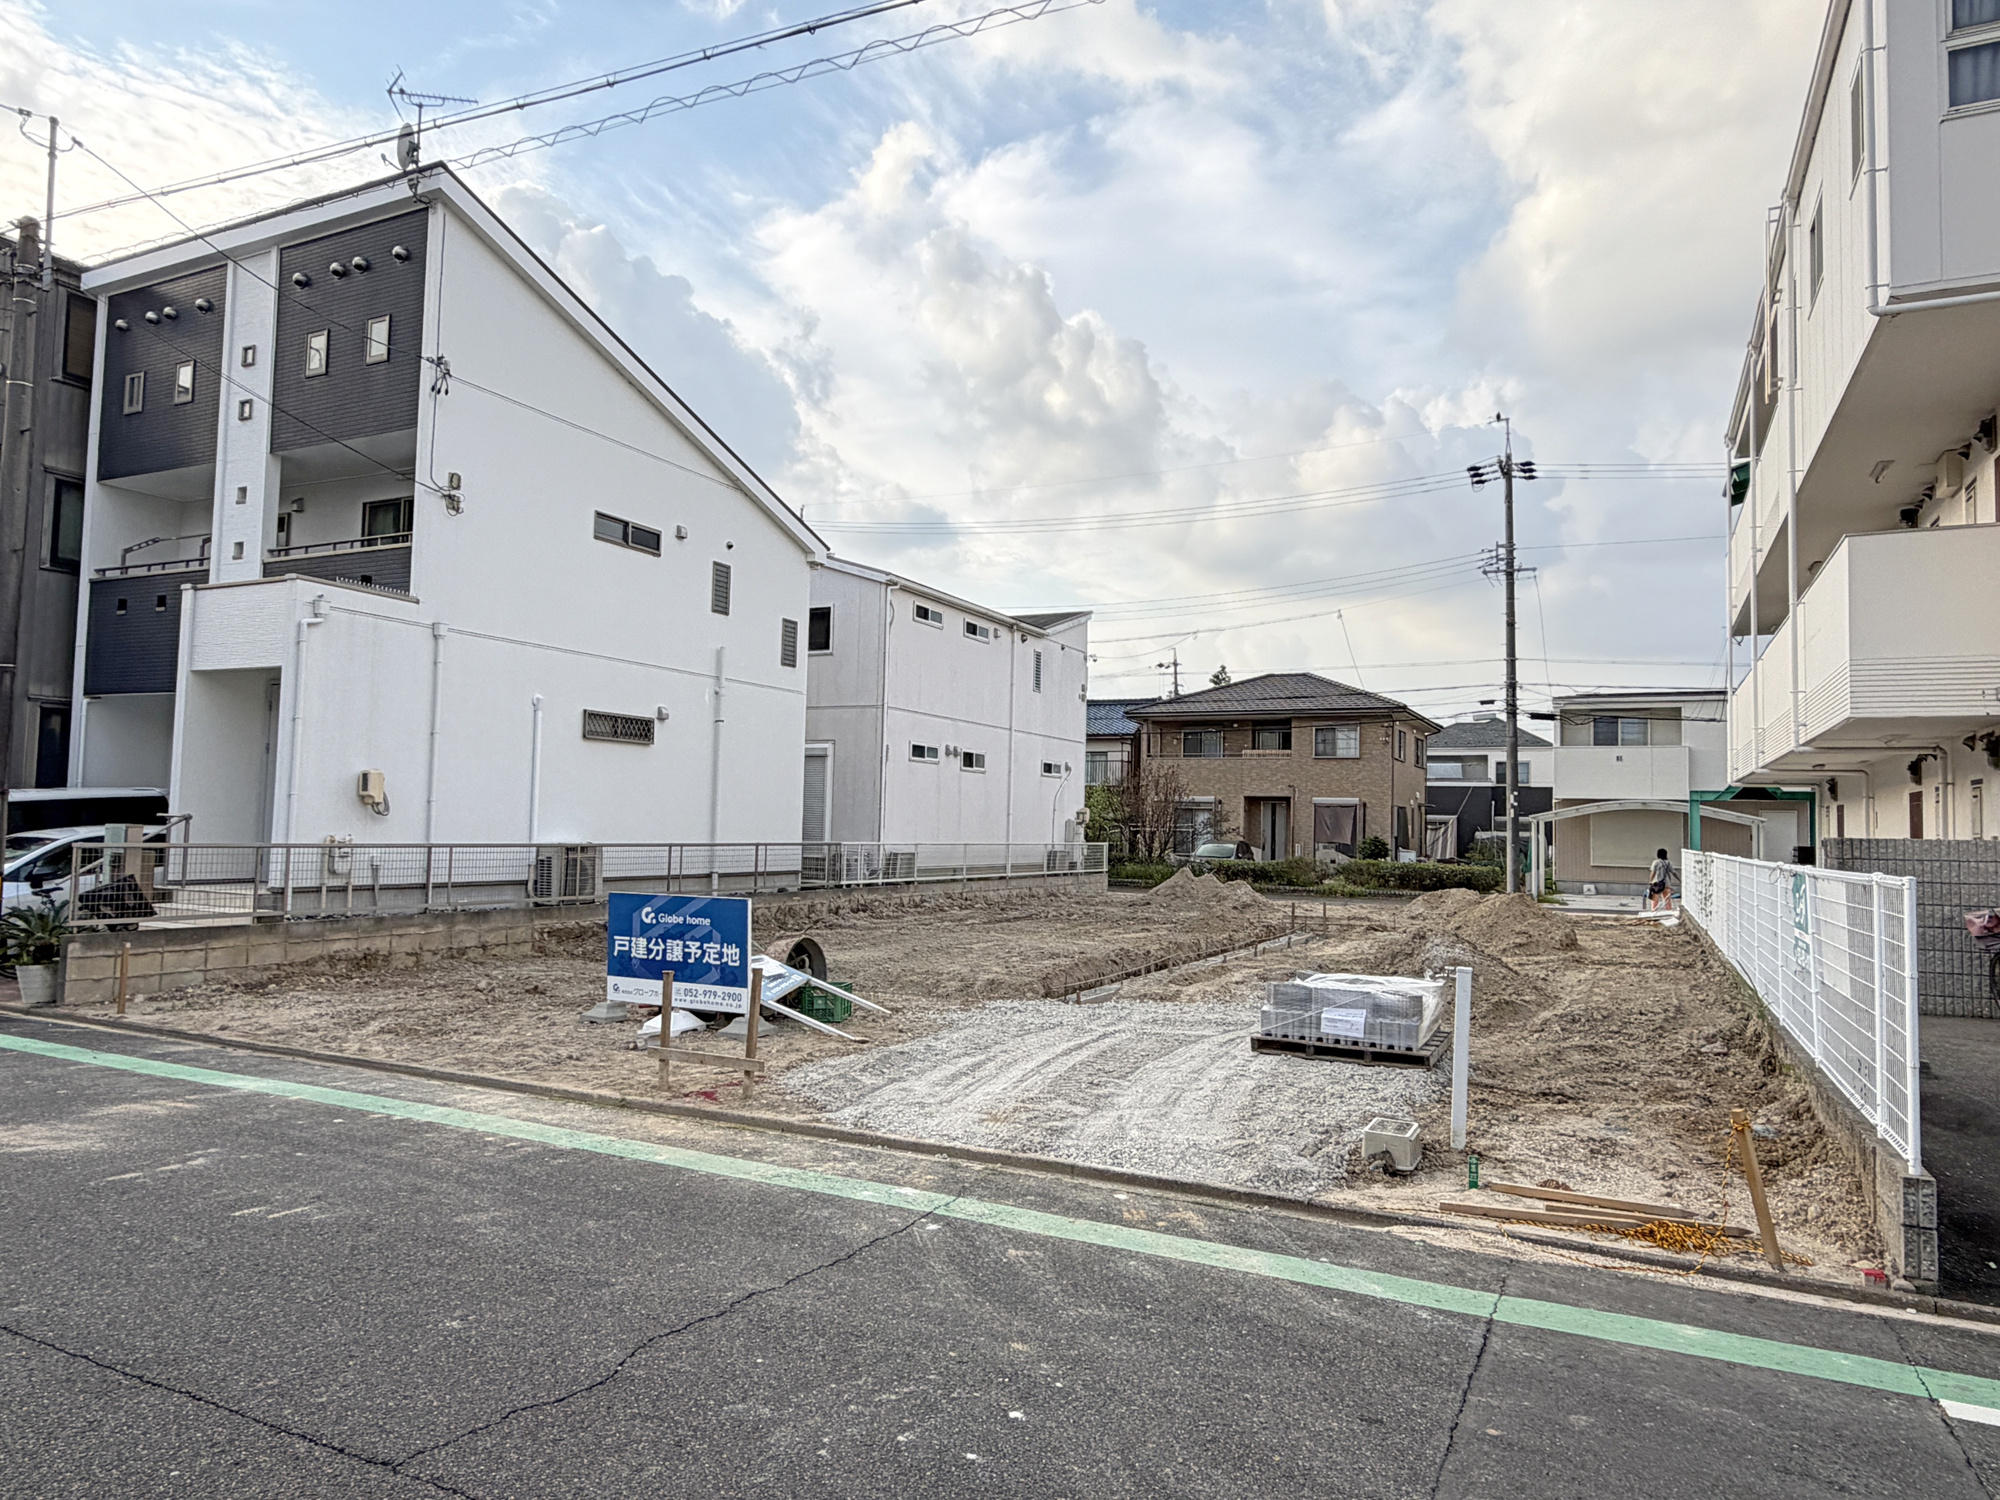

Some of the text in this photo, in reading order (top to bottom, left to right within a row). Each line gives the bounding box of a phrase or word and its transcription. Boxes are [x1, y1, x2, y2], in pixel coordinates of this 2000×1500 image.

[658, 913, 711, 926] Globe home
[613, 935, 740, 966] 戸建分譲予定地
[683, 988, 742, 1002] 052-979-2900
